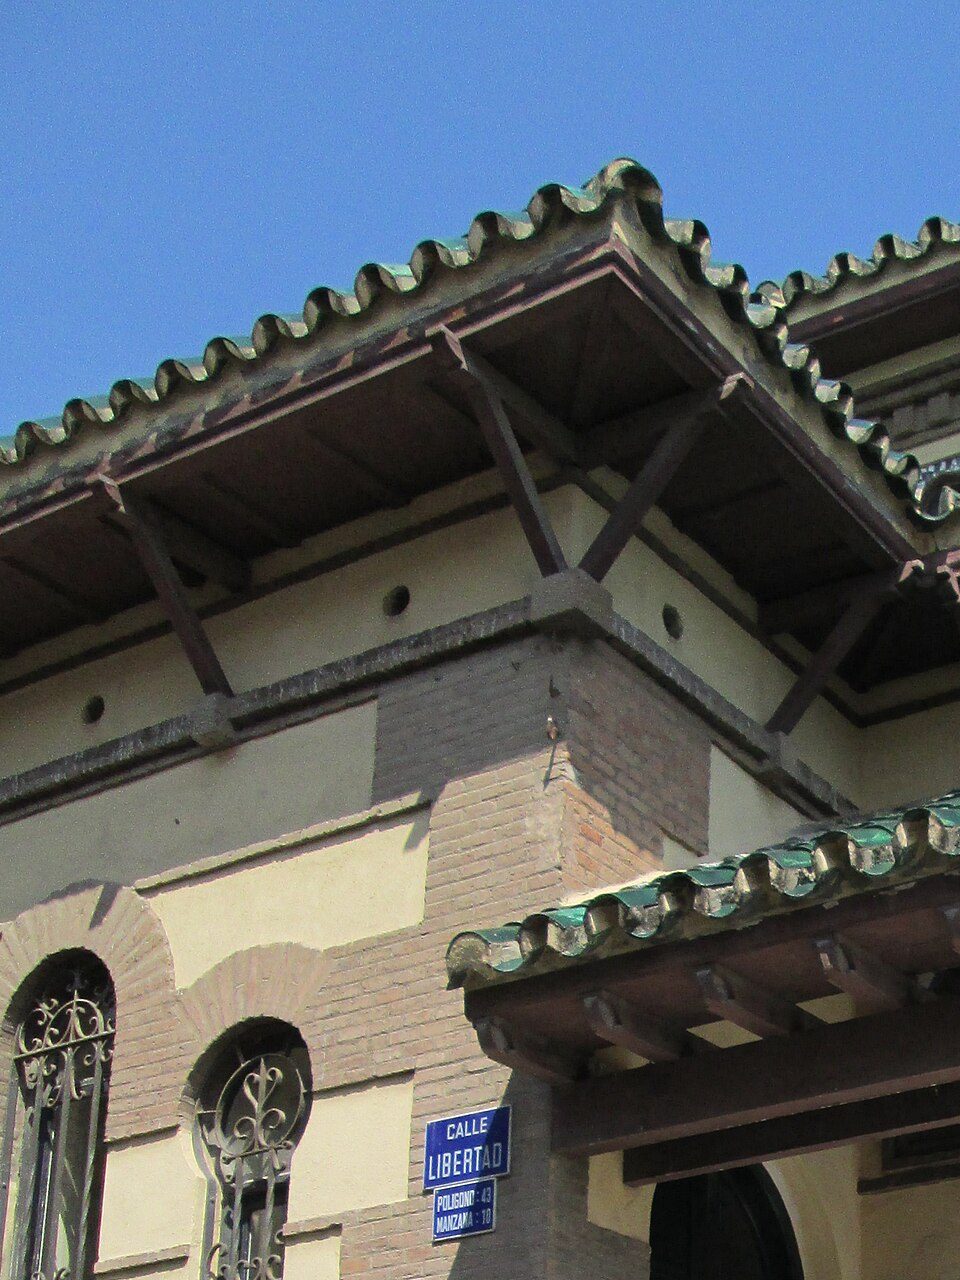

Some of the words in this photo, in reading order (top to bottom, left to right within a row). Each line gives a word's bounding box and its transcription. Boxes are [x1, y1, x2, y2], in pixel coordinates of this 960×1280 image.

[447, 1116, 489, 1140] CALLE
[428, 1142, 503, 1181] LIBERTAD
[437, 1189, 475, 1212] POLIGONO
[436, 1211, 474, 1233] MANZANA
